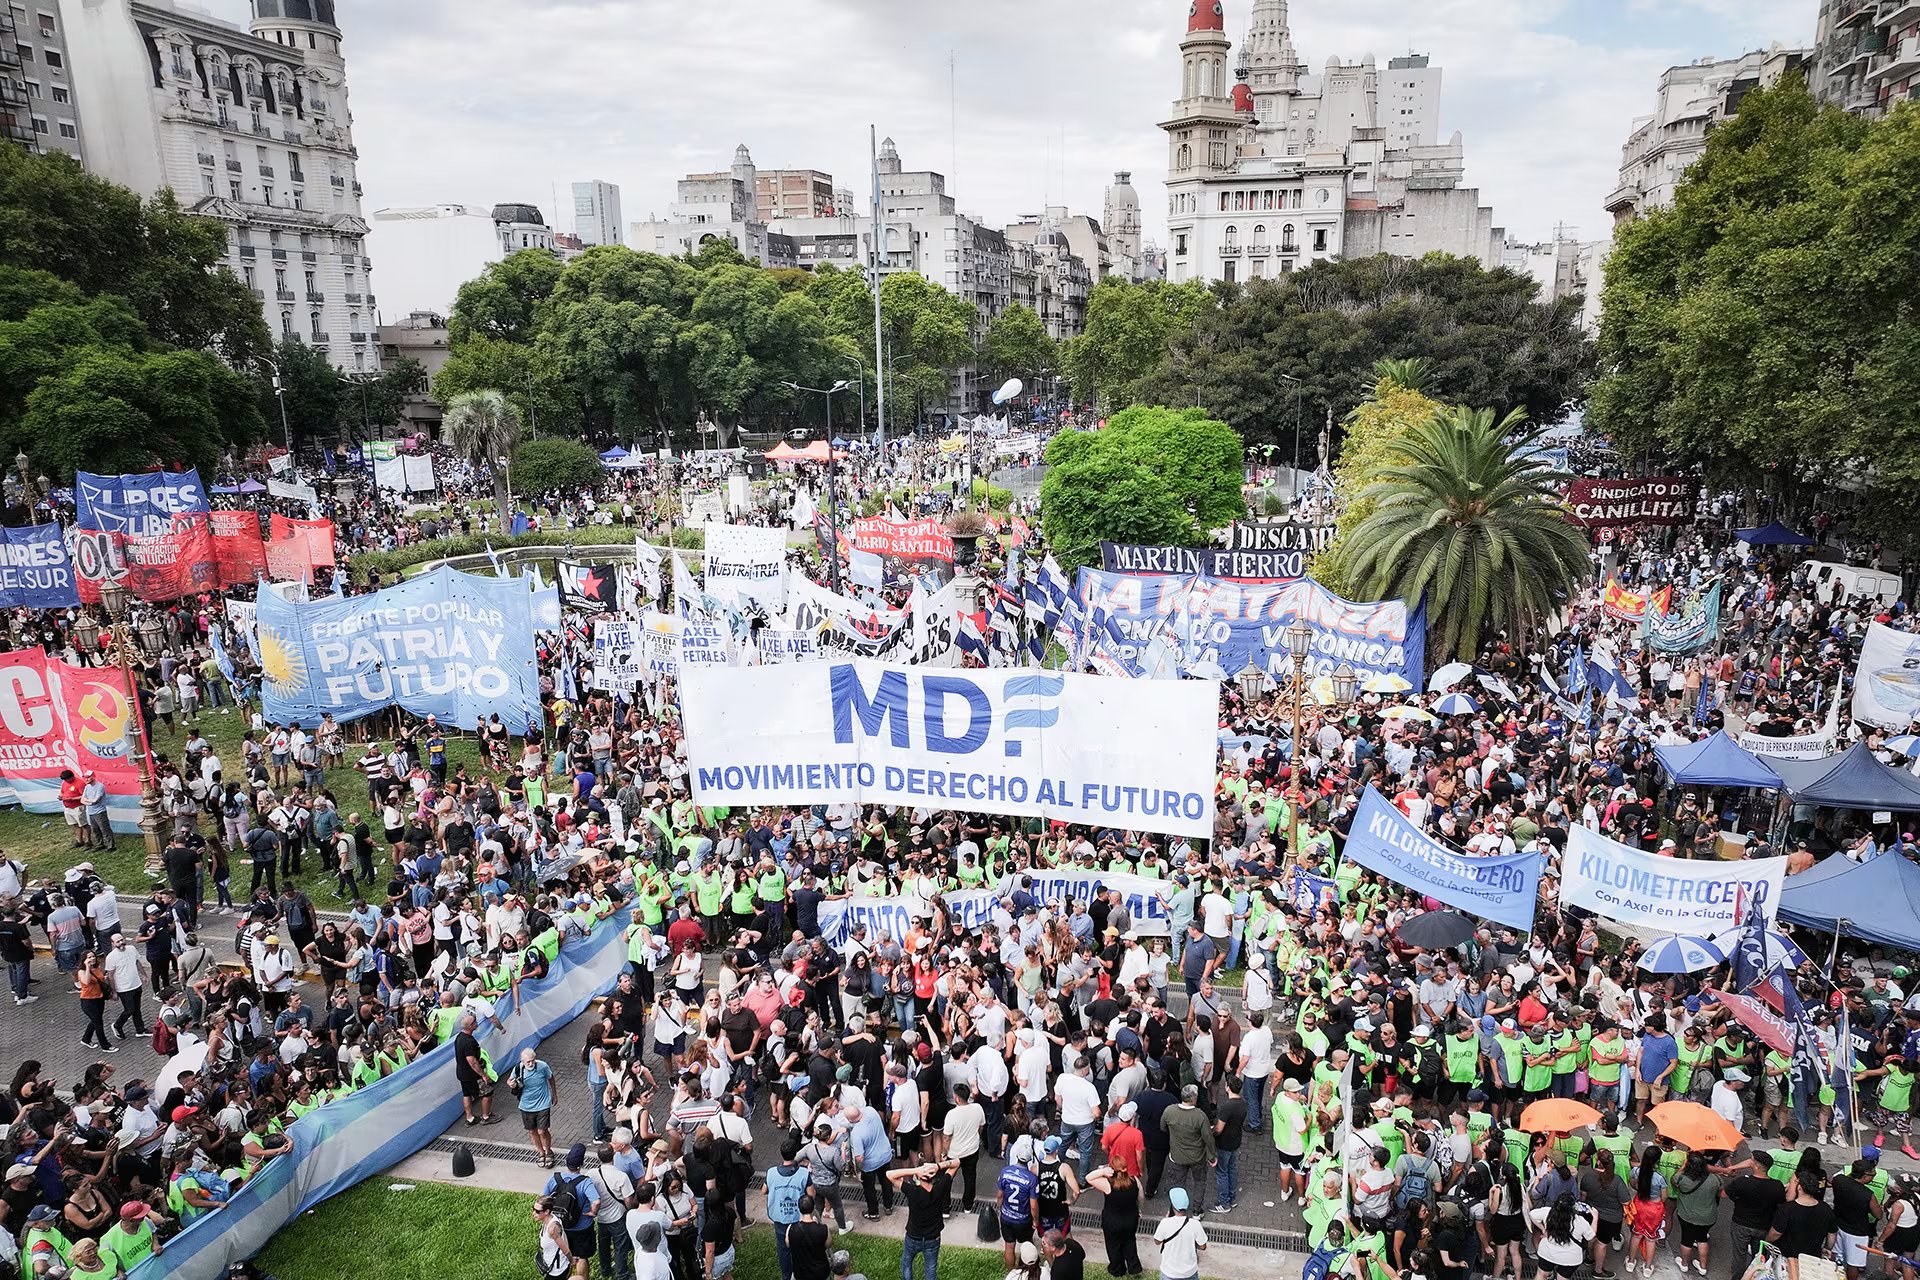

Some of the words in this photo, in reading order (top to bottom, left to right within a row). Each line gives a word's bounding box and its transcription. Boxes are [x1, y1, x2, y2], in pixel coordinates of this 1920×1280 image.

[1590, 484, 1667, 499] SINDICATO
[1670, 484, 1688, 496] DE
[856, 519, 895, 536] FRENTE
[148, 554, 177, 565] LUCHA
[1114, 545, 1201, 574] MARTIN
[1214, 552, 1303, 578] FIERRO
[25, 567, 69, 589] SUR
[312, 608, 398, 640] FRENTE
[406, 601, 504, 628] POPULAR
[1156, 578, 1406, 642] MATANZA
[607, 632, 635, 647] AXEL
[683, 627, 722, 637] AXEL
[317, 625, 472, 673] PATRIA
[478, 628, 504, 661] Y
[762, 638, 785, 653] AXEL
[787, 638, 815, 653] AXEL
[326, 662, 509, 705] FUTURO
[97, 745, 117, 757] PCCE
[698, 762, 875, 792] MOVIMIENTO
[884, 766, 1028, 803] DERECHO
[1035, 778, 1074, 807] AL
[1082, 783, 1205, 820] FUTURO
[1380, 848, 1402, 866] Con
[1403, 862, 1429, 881] Axel
[1595, 890, 1621, 905] Con
[1623, 898, 1654, 914] Axel
[1656, 907, 1674, 917] en
[1008, 1183, 1020, 1204] 2
